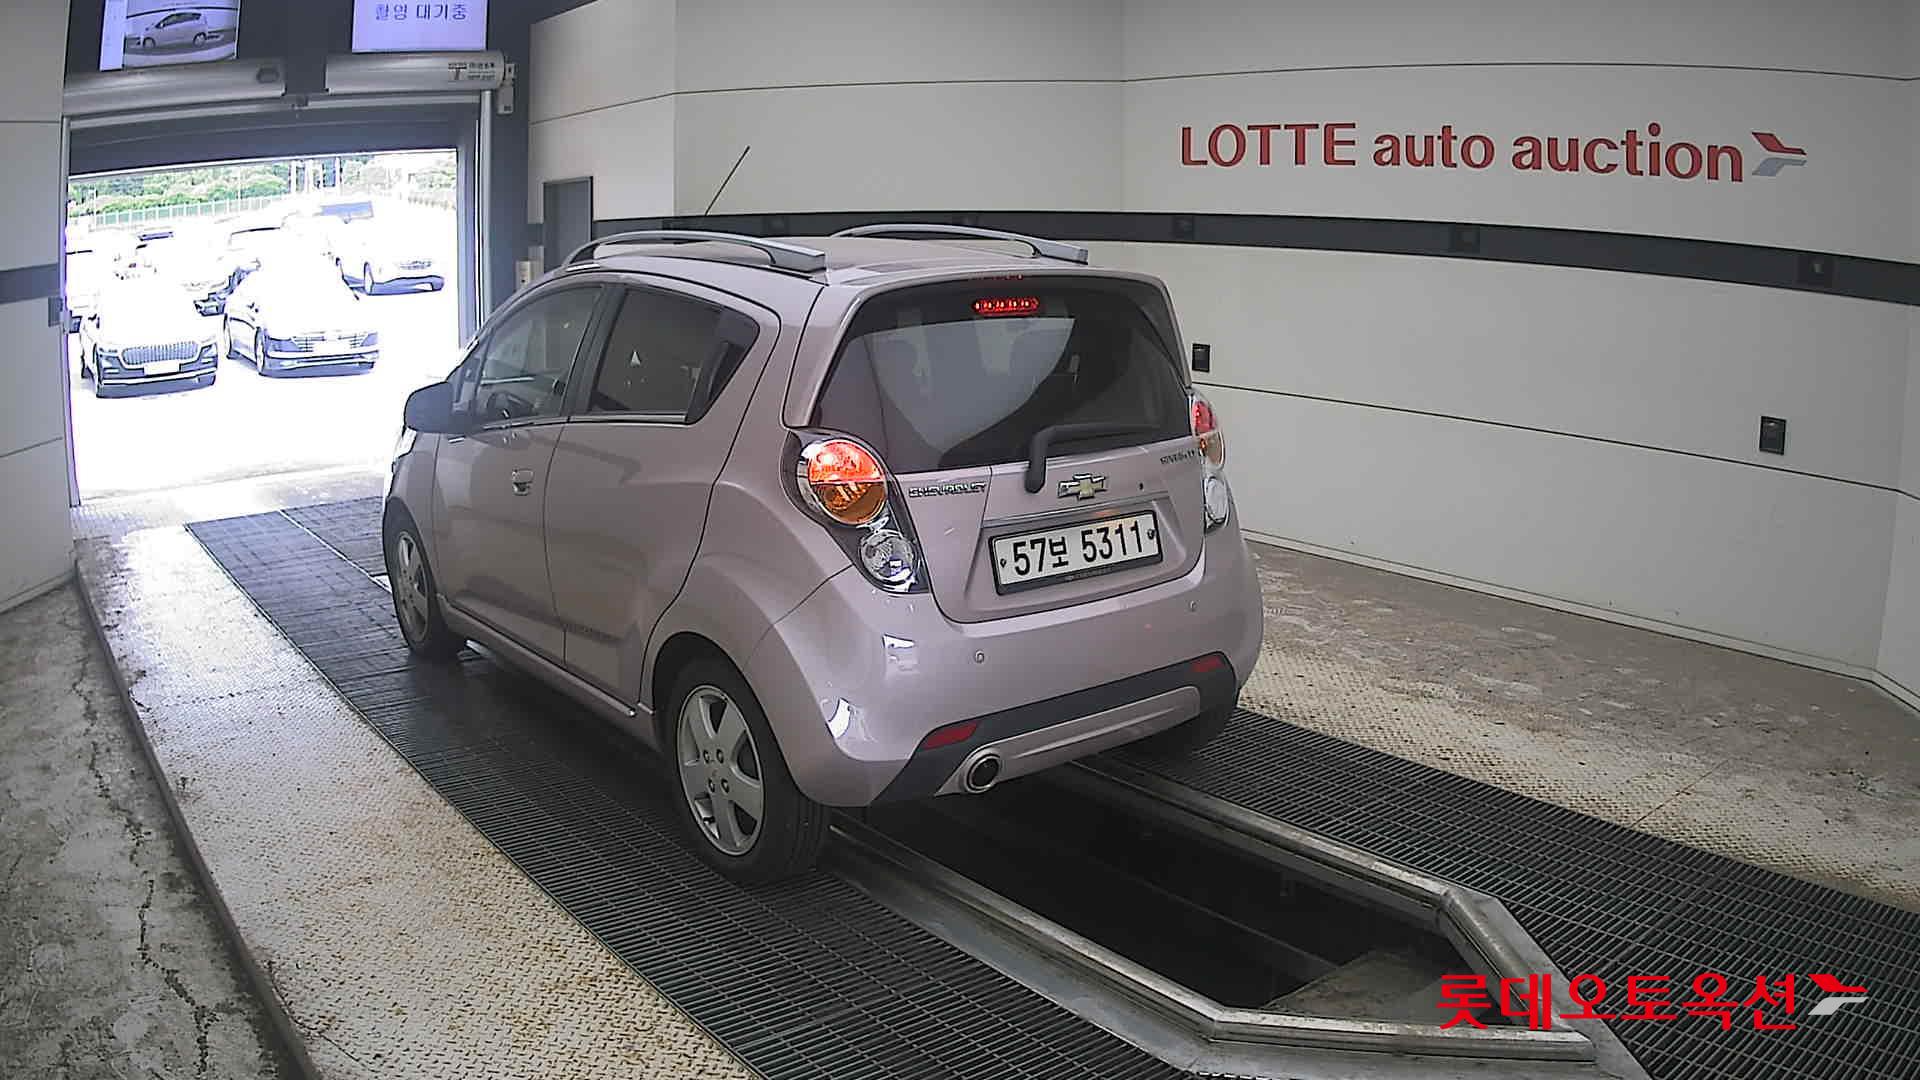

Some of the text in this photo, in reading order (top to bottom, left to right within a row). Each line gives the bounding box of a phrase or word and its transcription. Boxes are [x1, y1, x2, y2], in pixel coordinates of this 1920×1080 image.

[416, 3, 467, 20] 대기중
[1181, 121, 1744, 183] LOTTE auto auction
[1013, 520, 1143, 576] 57보 5311
